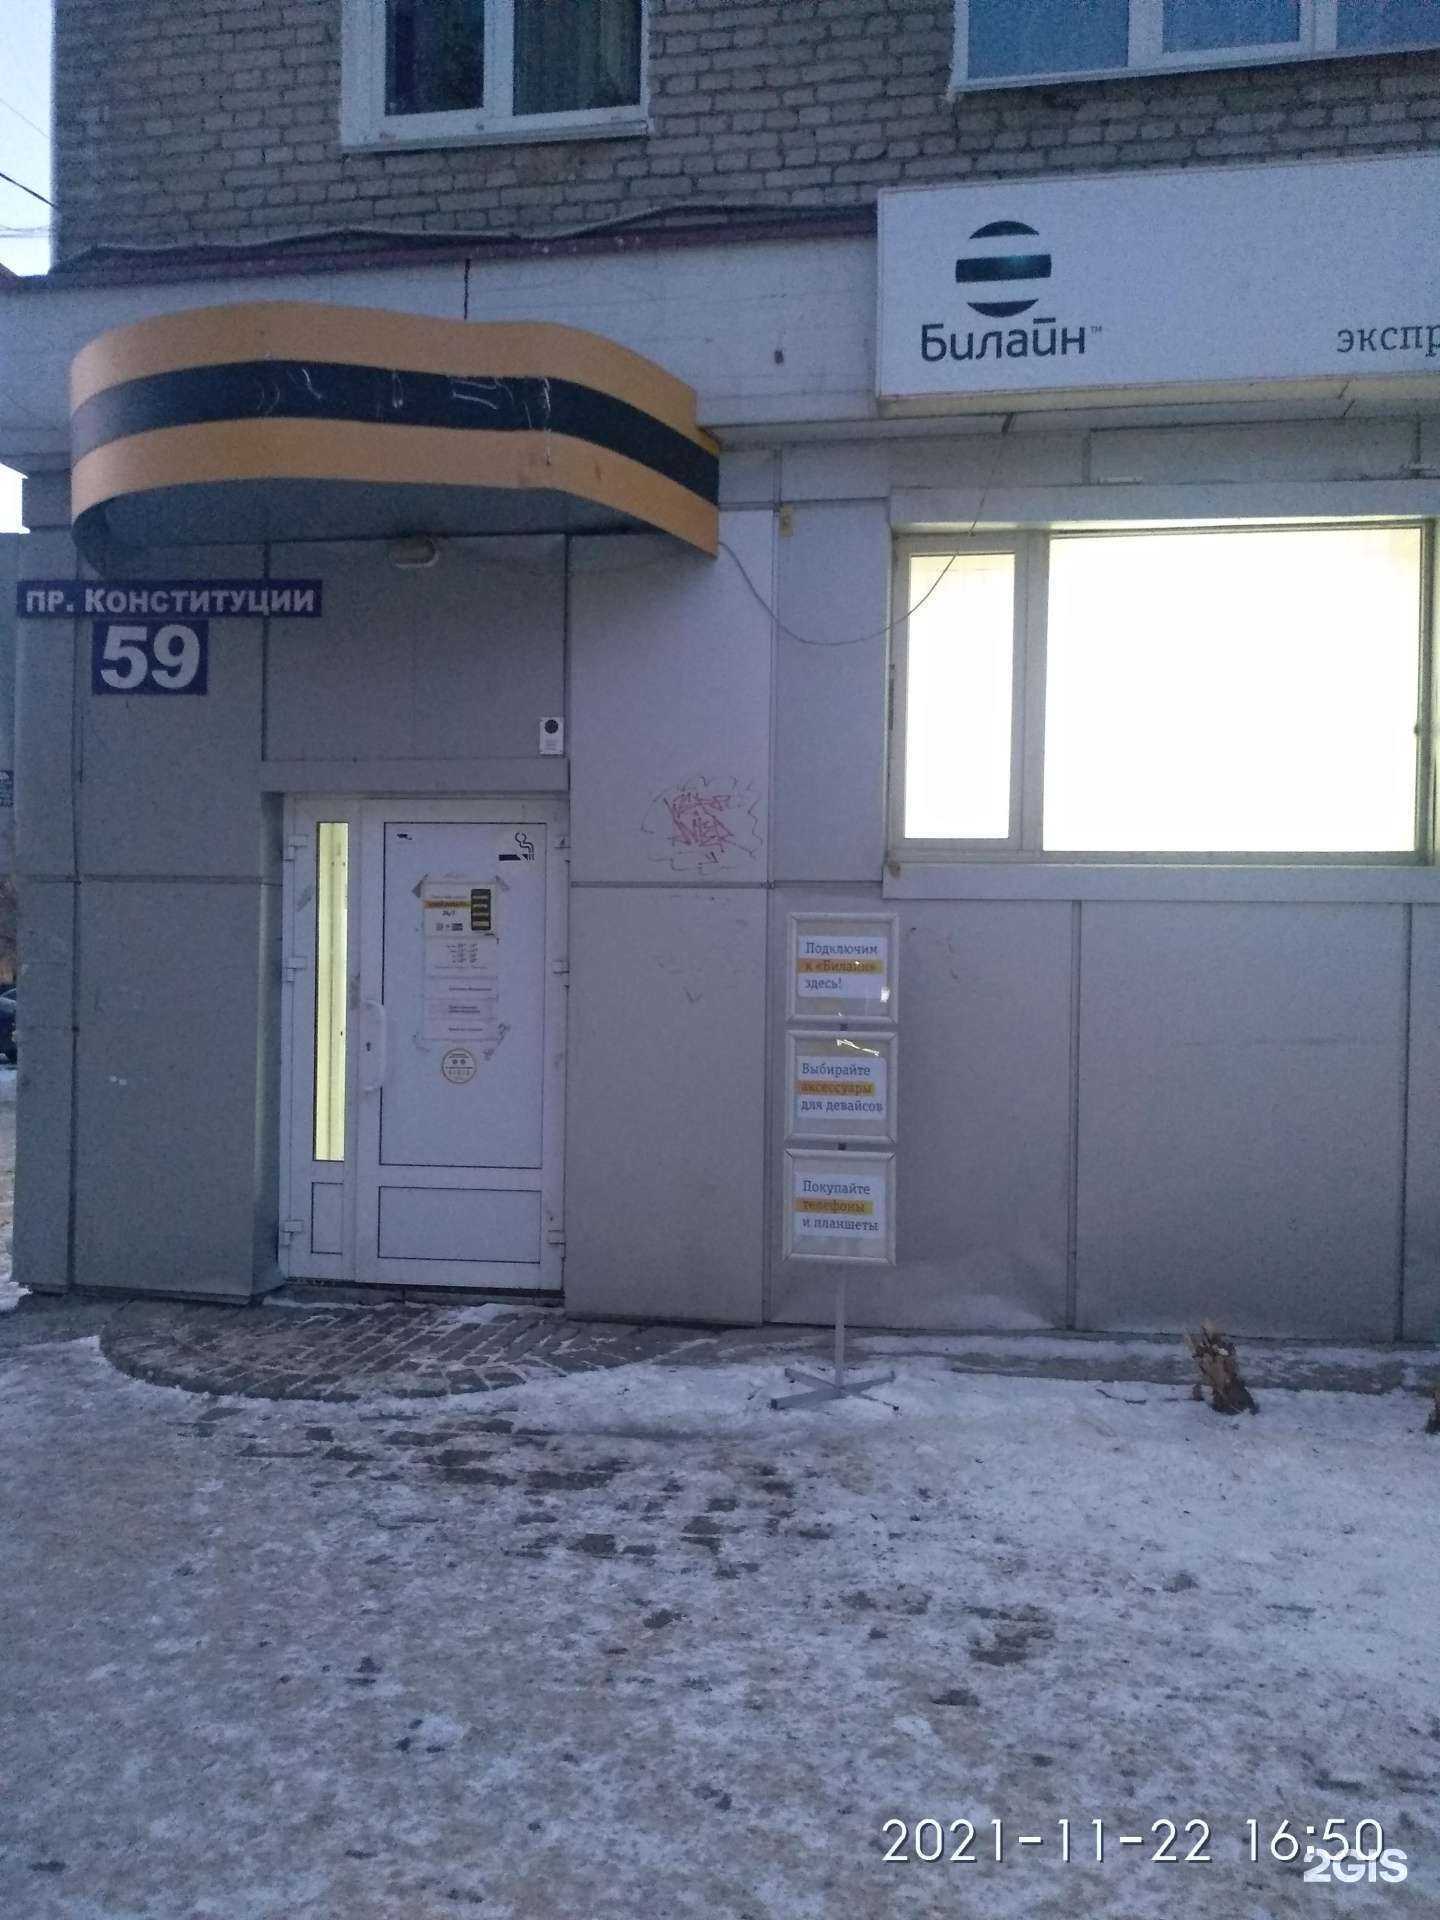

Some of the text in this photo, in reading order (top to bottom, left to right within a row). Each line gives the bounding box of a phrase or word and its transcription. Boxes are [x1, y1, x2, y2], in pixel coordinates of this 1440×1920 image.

[84, 588, 315, 616] КОНСТИТУЦИИ
[100, 623, 201, 690] 59
[804, 941, 879, 956] Подключим
[804, 976, 842, 990] здесь!
[801, 1062, 871, 1078] Выбирайте
[800, 1100, 884, 1113] для девайсов
[802, 1180, 871, 1196] Покупайте
[802, 1218, 880, 1232] и планшеты
